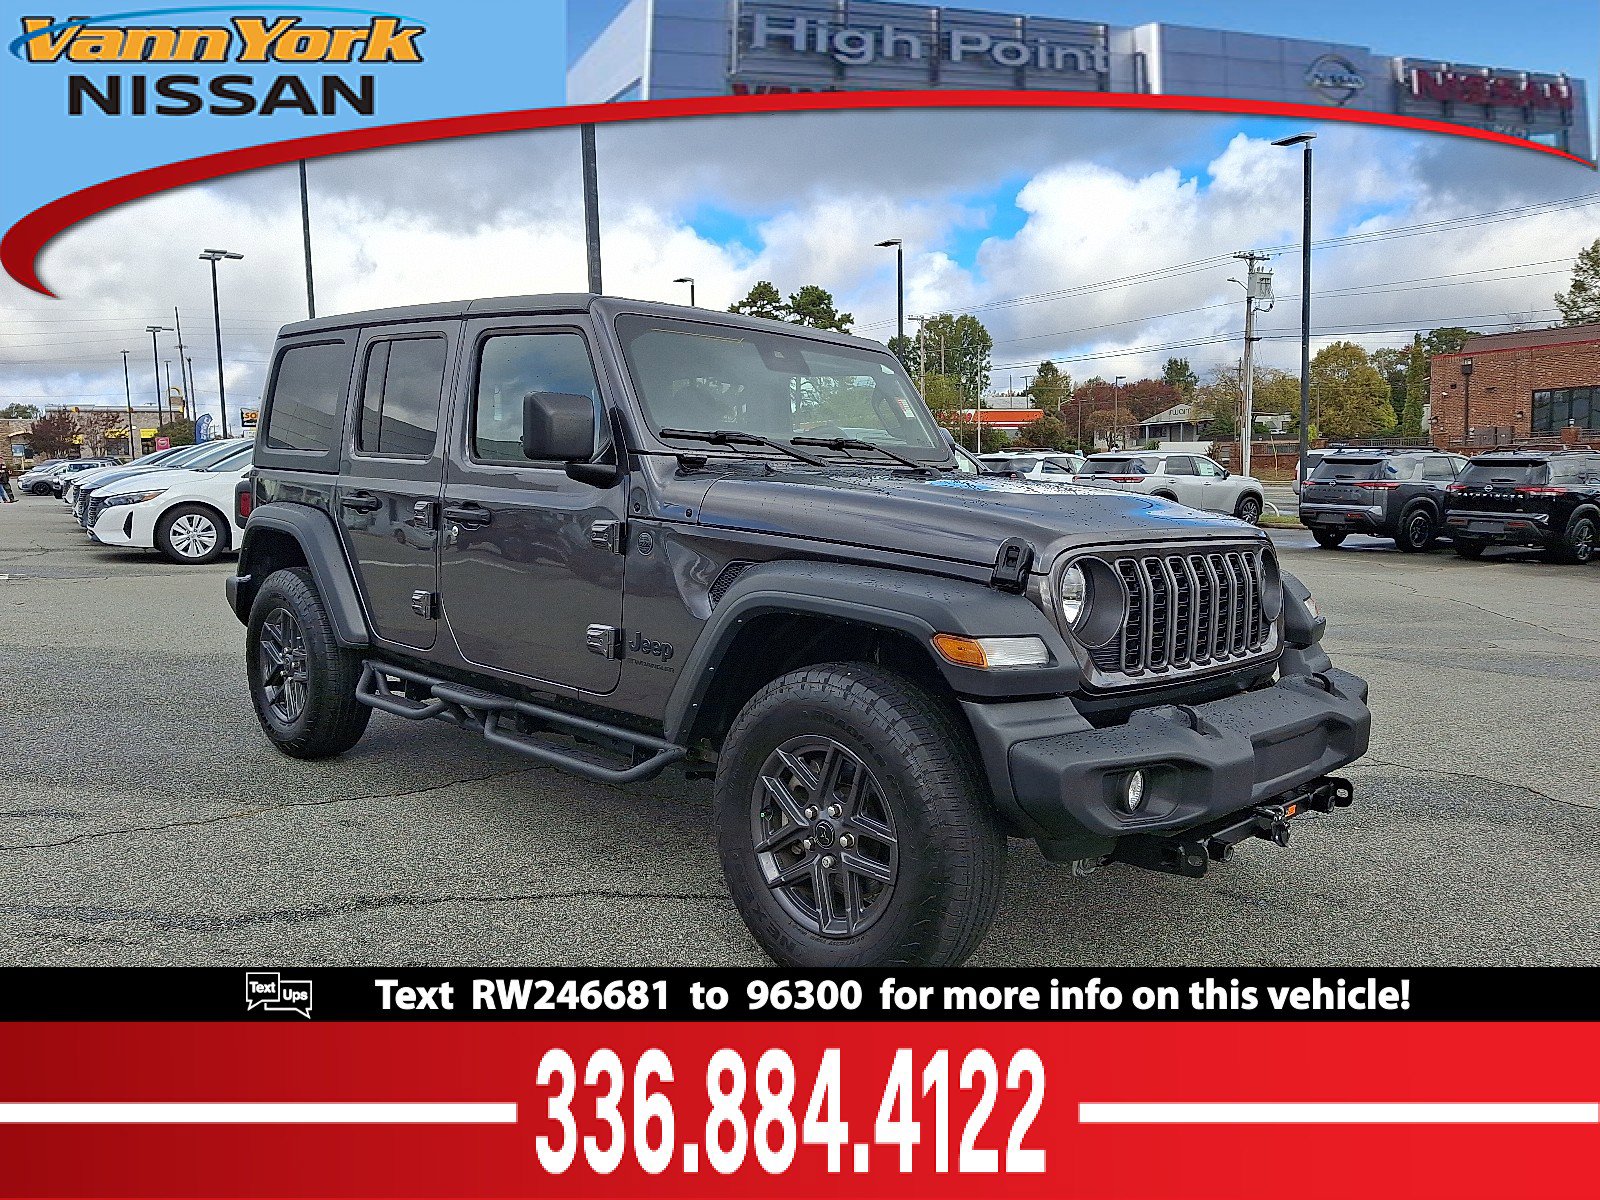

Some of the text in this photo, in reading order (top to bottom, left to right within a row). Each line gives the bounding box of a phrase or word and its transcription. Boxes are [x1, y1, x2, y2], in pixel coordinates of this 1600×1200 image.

[750, 13, 1110, 73] High Point
[628, 631, 674, 662] Jeep
